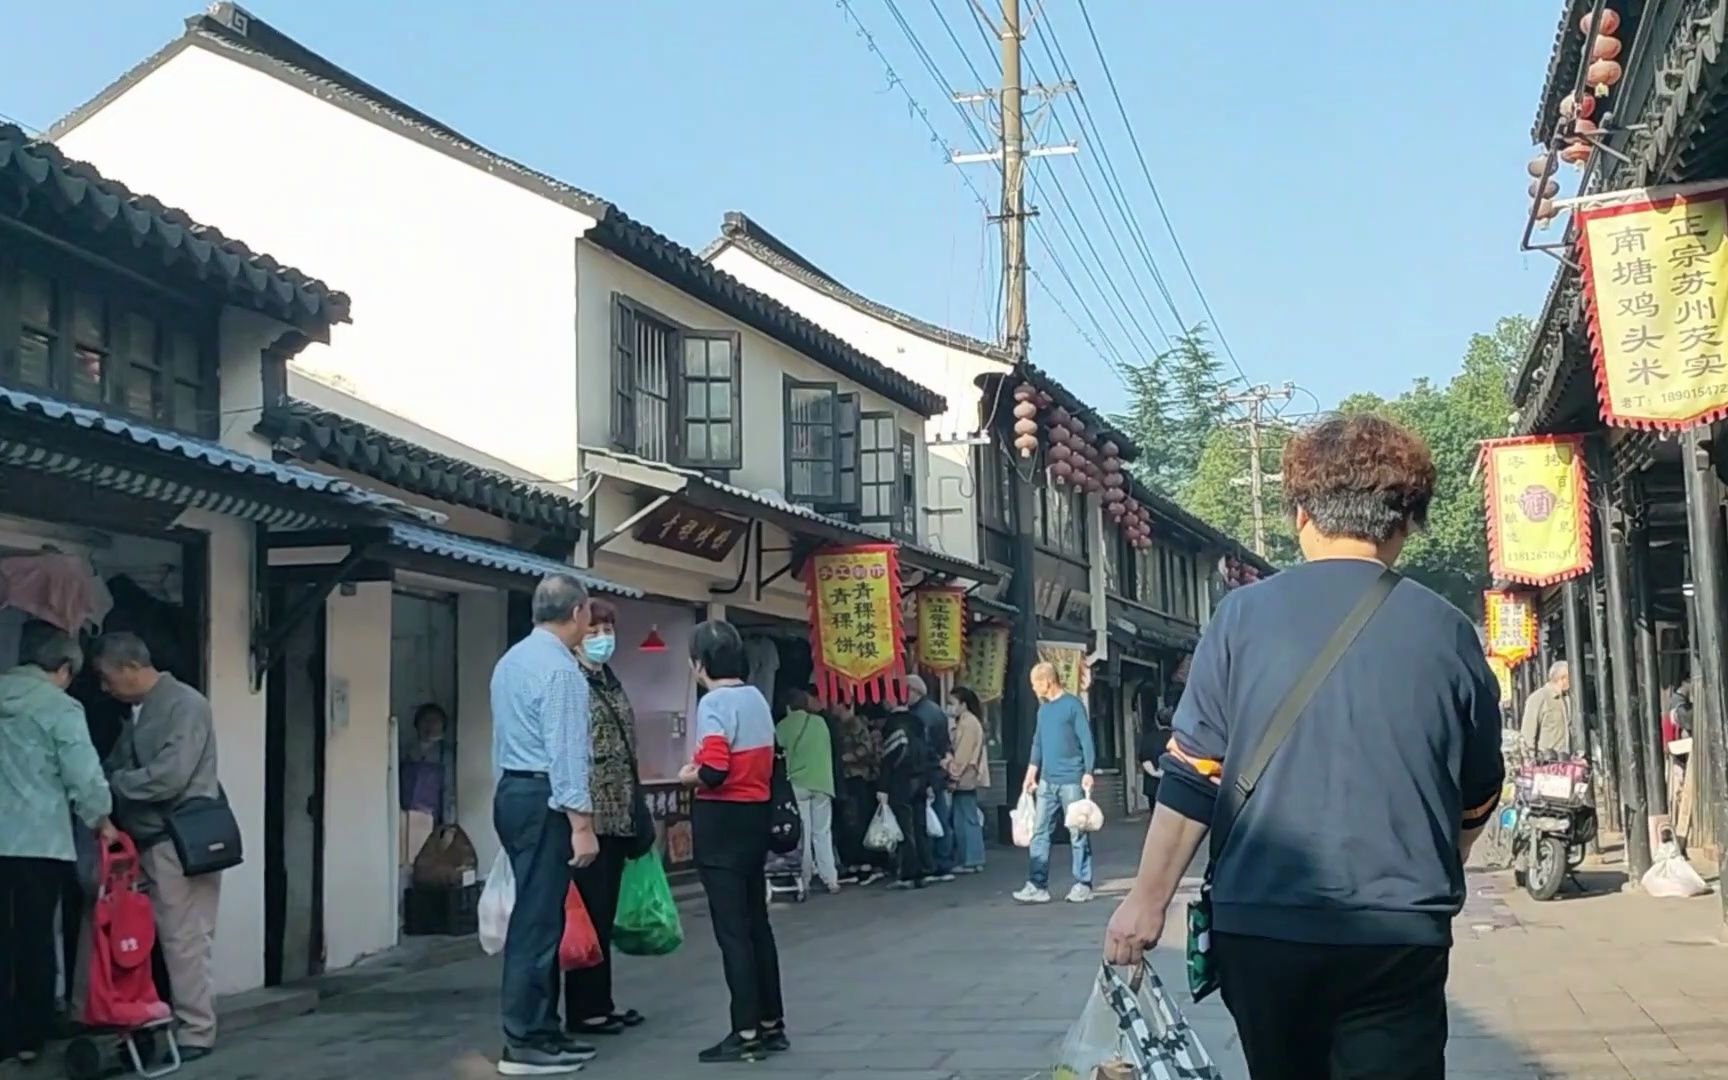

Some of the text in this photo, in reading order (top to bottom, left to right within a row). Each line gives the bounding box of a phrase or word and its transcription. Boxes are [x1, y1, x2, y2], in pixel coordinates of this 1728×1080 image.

[1607, 225, 1670, 386] 南塘鸡头米
[1665, 214, 1727, 379] 正宗苏州芡实
[829, 587, 857, 653] 青稞饼
[852, 581, 880, 659] 青稞烤馍
